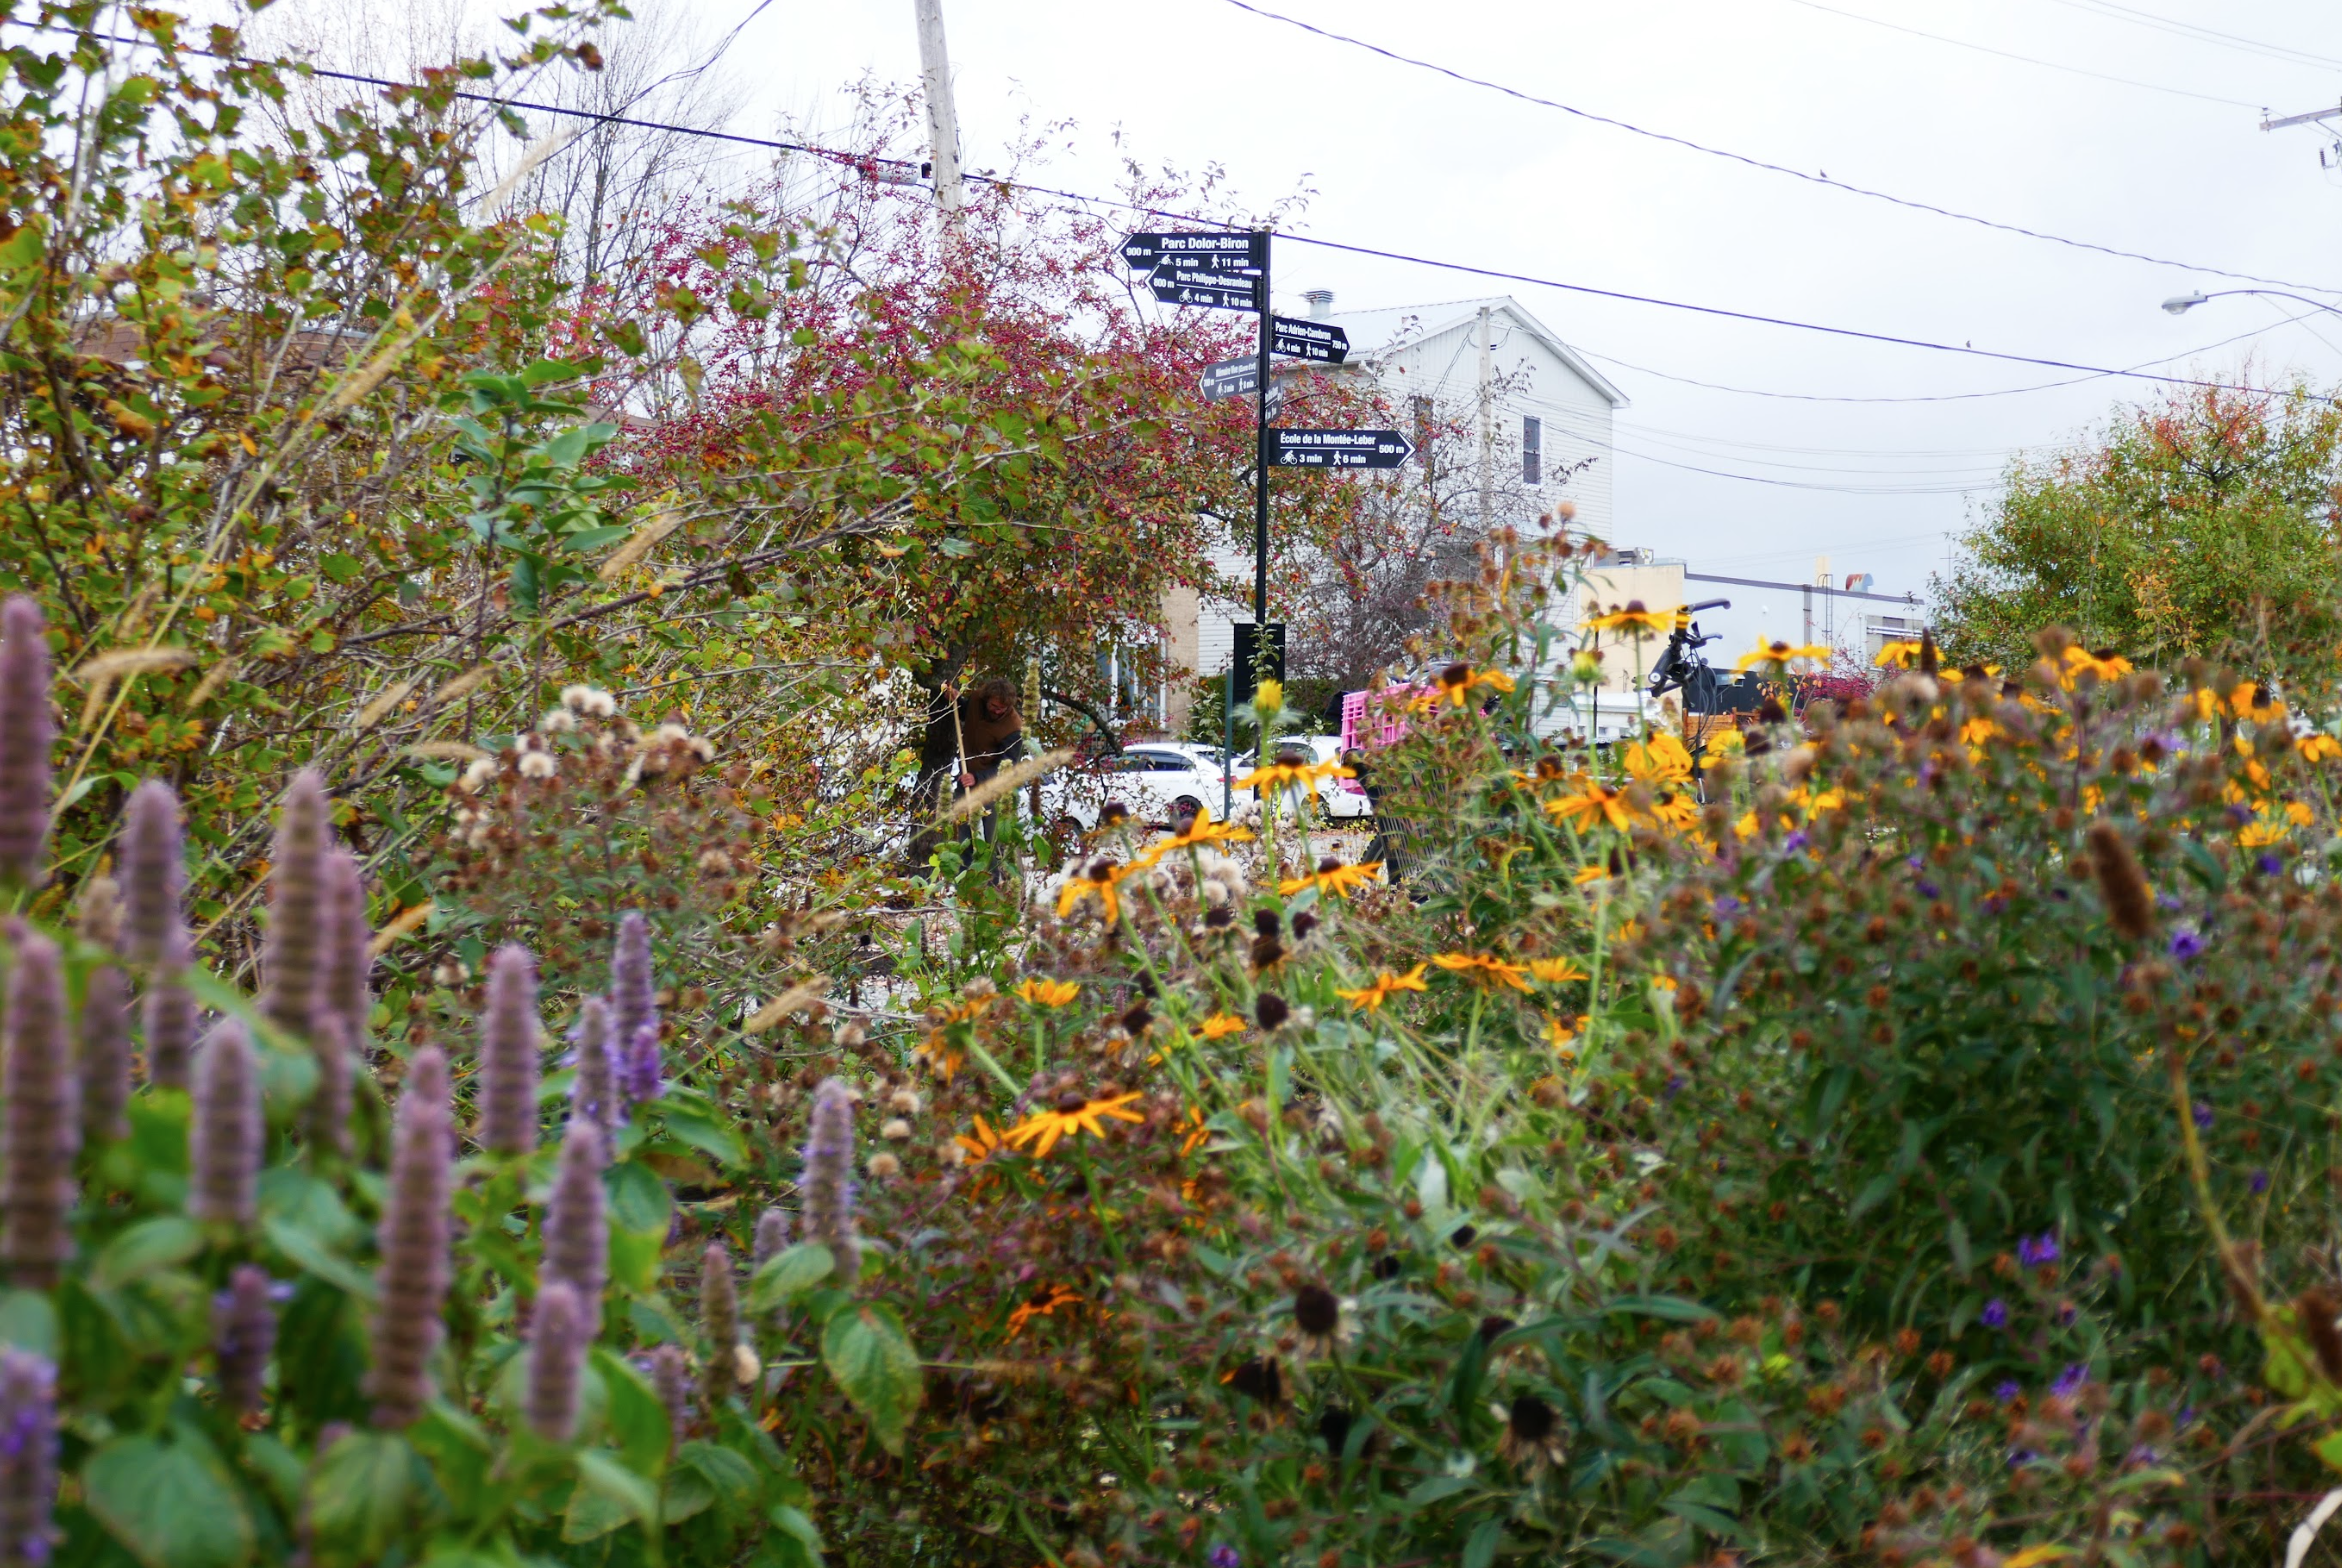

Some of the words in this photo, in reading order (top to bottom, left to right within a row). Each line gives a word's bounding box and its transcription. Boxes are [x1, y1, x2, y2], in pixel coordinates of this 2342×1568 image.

[1162, 237, 1186, 249] Parc
[1188, 237, 1249, 249] Dolor-Biron
[1126, 247, 1141, 256] 900
[1176, 258, 1182, 267] 5
[1183, 258, 1199, 267] min
[1222, 258, 1231, 267] 11
[1233, 258, 1249, 267] min
[1176, 271, 1192, 282] Parc
[1167, 280, 1174, 288] m
[1194, 293, 1199, 302] 4
[1200, 294, 1213, 303] min
[1231, 297, 1239, 306] 10
[1240, 298, 1252, 307] min
[1275, 322, 1288, 332] Parc
[1291, 344, 1300, 353] min
[1312, 347, 1318, 356] 10
[1319, 349, 1328, 357] min
[1280, 431, 1301, 444] École
[1302, 434, 1312, 444] de
[1314, 434, 1321, 444] la
[1323, 434, 1376, 445] Montée-Leber
[1379, 445, 1394, 454] 500
[1396, 446, 1404, 454] m
[1300, 454, 1305, 463] 3
[1306, 454, 1322, 463] min
[1343, 455, 1348, 463] 6
[1350, 455, 1366, 463] min
